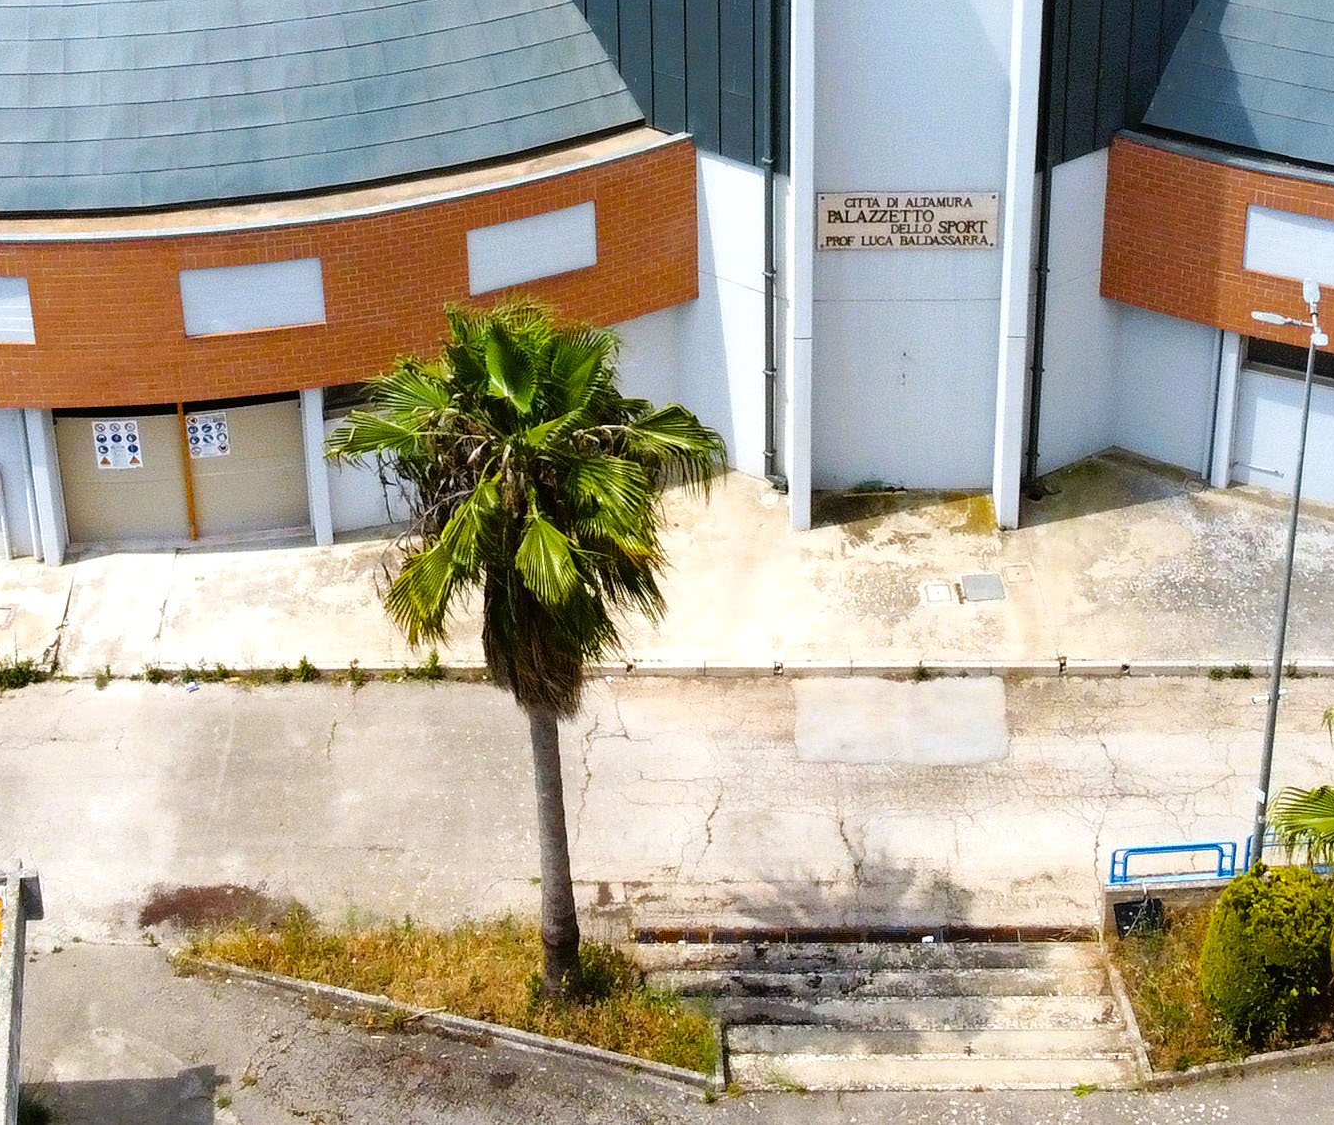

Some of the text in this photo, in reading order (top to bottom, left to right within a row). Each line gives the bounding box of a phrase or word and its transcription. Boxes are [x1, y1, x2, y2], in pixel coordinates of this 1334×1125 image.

[887, 197, 898, 208] DI
[905, 197, 972, 208] ALTAMURA
[827, 209, 934, 223] PALAZZETTO
[890, 220, 988, 234] DELLO SPORT
[825, 235, 989, 246] PROF LUCA BALDASSARRA
